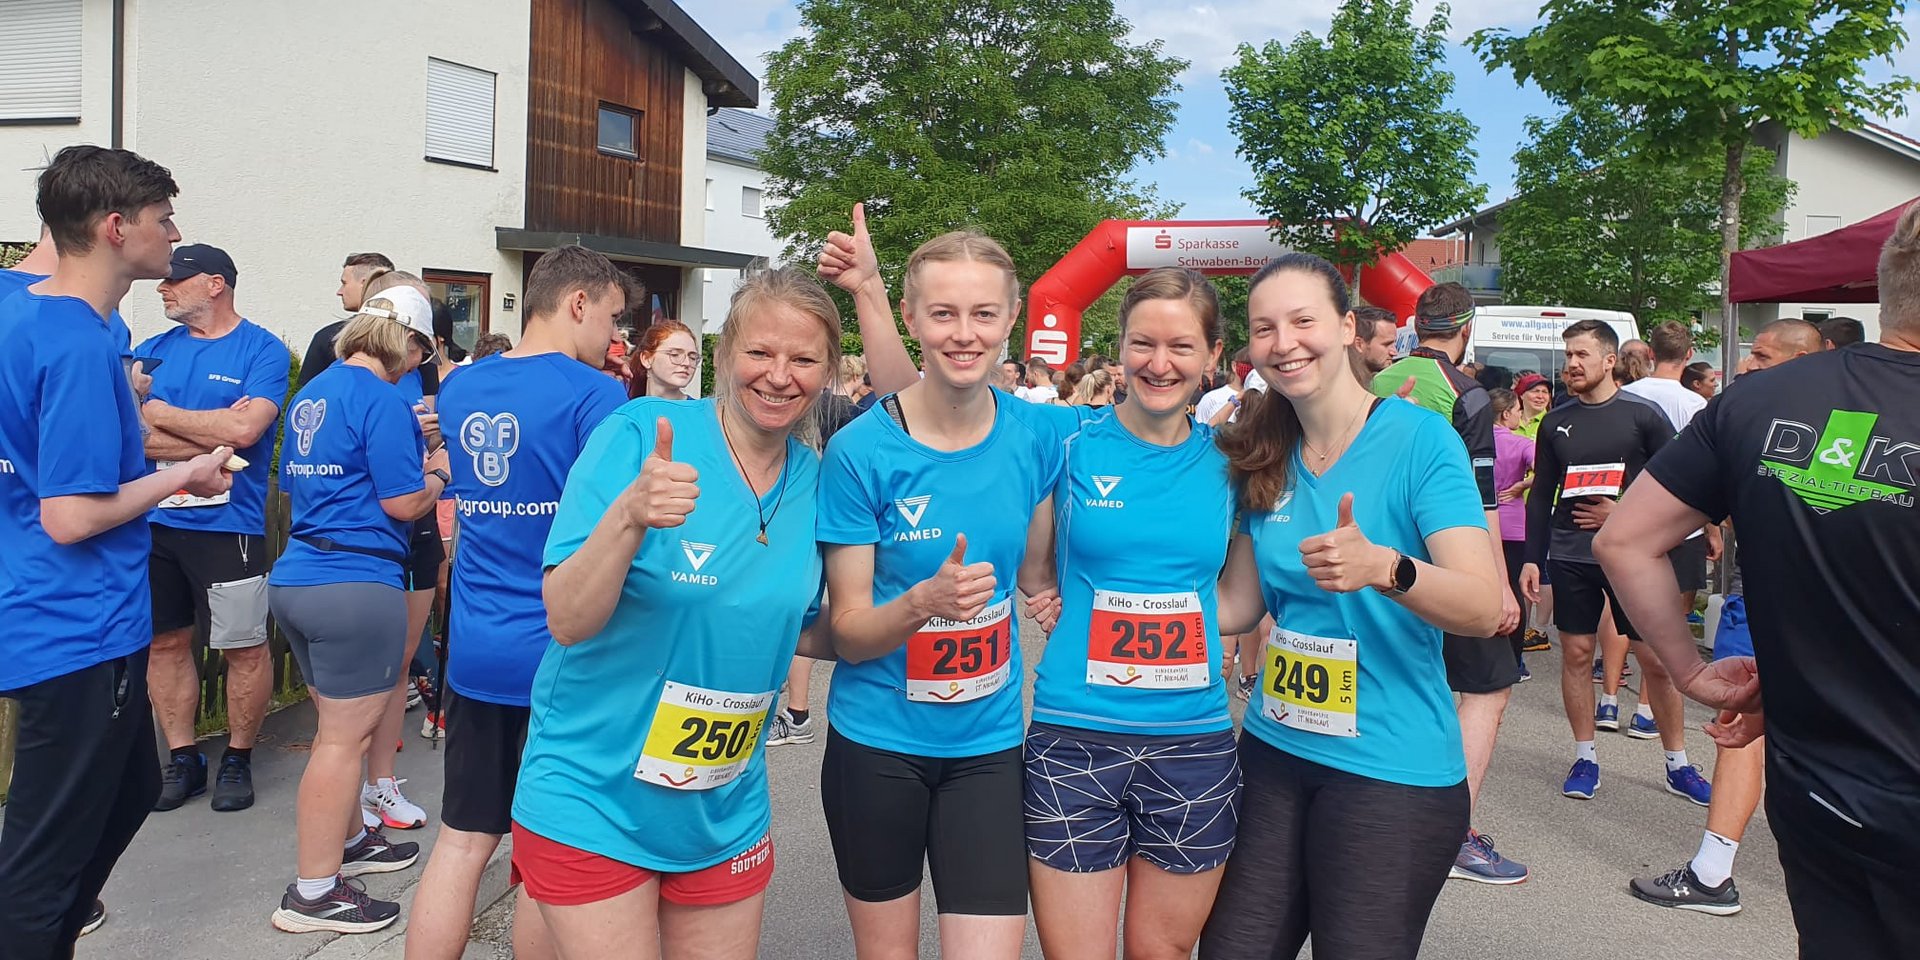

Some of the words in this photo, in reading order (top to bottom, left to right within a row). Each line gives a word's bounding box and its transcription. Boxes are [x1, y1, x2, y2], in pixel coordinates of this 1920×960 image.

[1178, 239, 1239, 251] Sparkasse
[1492, 332, 1520, 341] Service
[1522, 333, 1533, 342] für
[1577, 472, 1607, 487] 171
[1757, 464, 1915, 508] SPEZIAL-TIEFBAU
[1085, 498, 1124, 509] VAMED
[893, 527, 943, 542] VAMED
[671, 570, 719, 586] VAMED
[1108, 596, 1133, 608] KiHo
[1142, 597, 1188, 610] Crosslauf
[1195, 617, 1203, 638] km
[1110, 619, 1188, 660] 252
[1292, 638, 1335, 654] Crosslauf
[932, 629, 999, 675] 251
[1196, 641, 1205, 658] 10
[1273, 655, 1330, 704] 249
[1339, 670, 1352, 692] km
[685, 692, 714, 706] KiHo
[723, 697, 765, 709] Crosslauf
[1340, 696, 1352, 704] 5
[672, 717, 751, 760] 250
